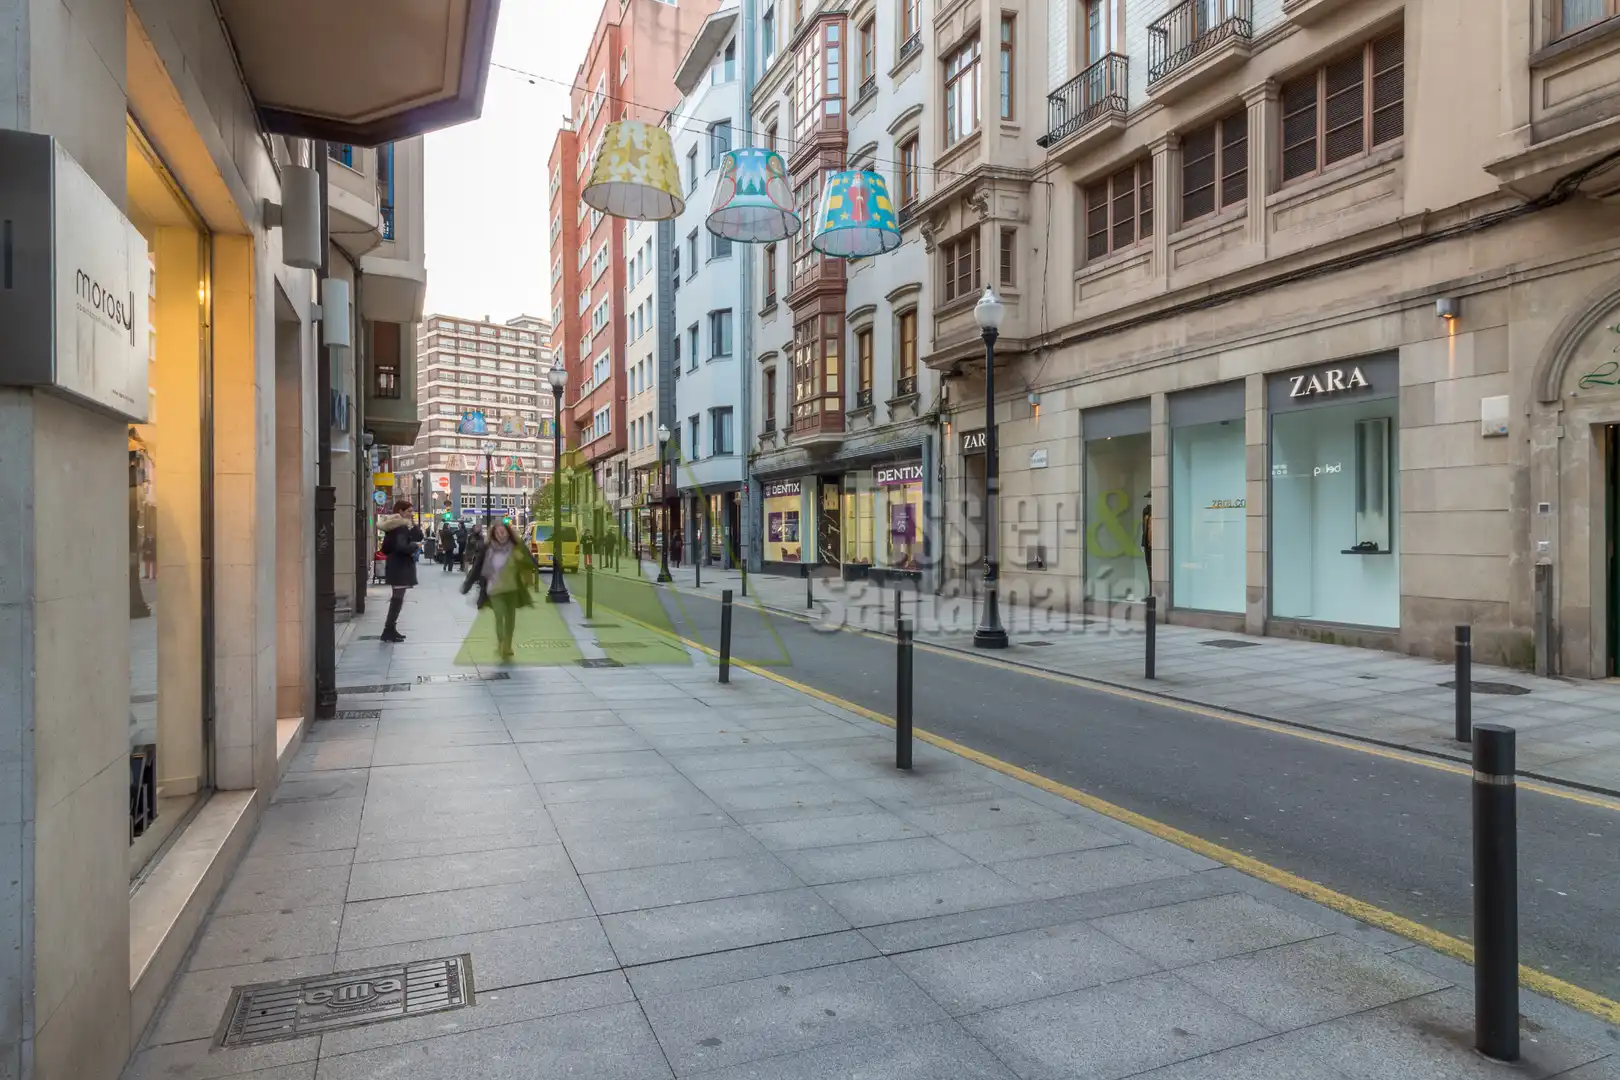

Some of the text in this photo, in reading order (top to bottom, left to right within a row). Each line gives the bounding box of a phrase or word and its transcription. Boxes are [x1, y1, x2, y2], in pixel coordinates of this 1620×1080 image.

[1289, 366, 1369, 398] ZARA
[963, 432, 988, 449] ZAR
[877, 465, 923, 483] DENTIX
[772, 482, 800, 495] DENTIX
[1212, 497, 1246, 508] zara.co
[304, 979, 402, 1005] ema
